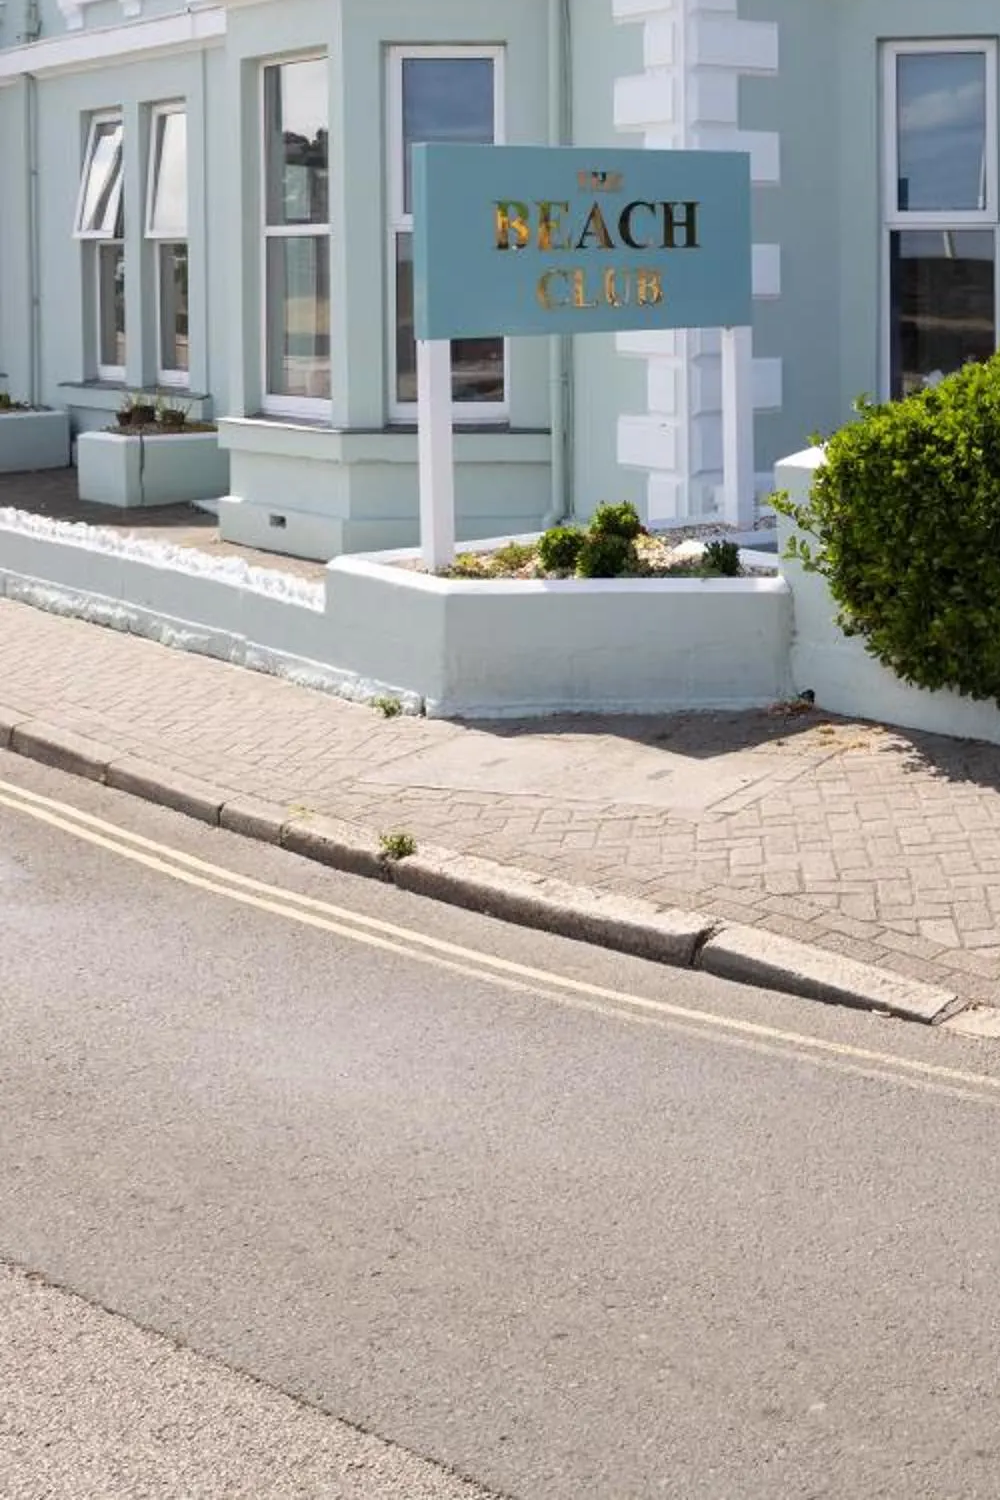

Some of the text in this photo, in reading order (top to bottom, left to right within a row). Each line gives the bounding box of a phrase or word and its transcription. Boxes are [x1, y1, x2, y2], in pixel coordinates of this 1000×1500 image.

[576, 169, 624, 192] THE
[494, 200, 700, 250] BEACH
[536, 266, 664, 310] CLUB
